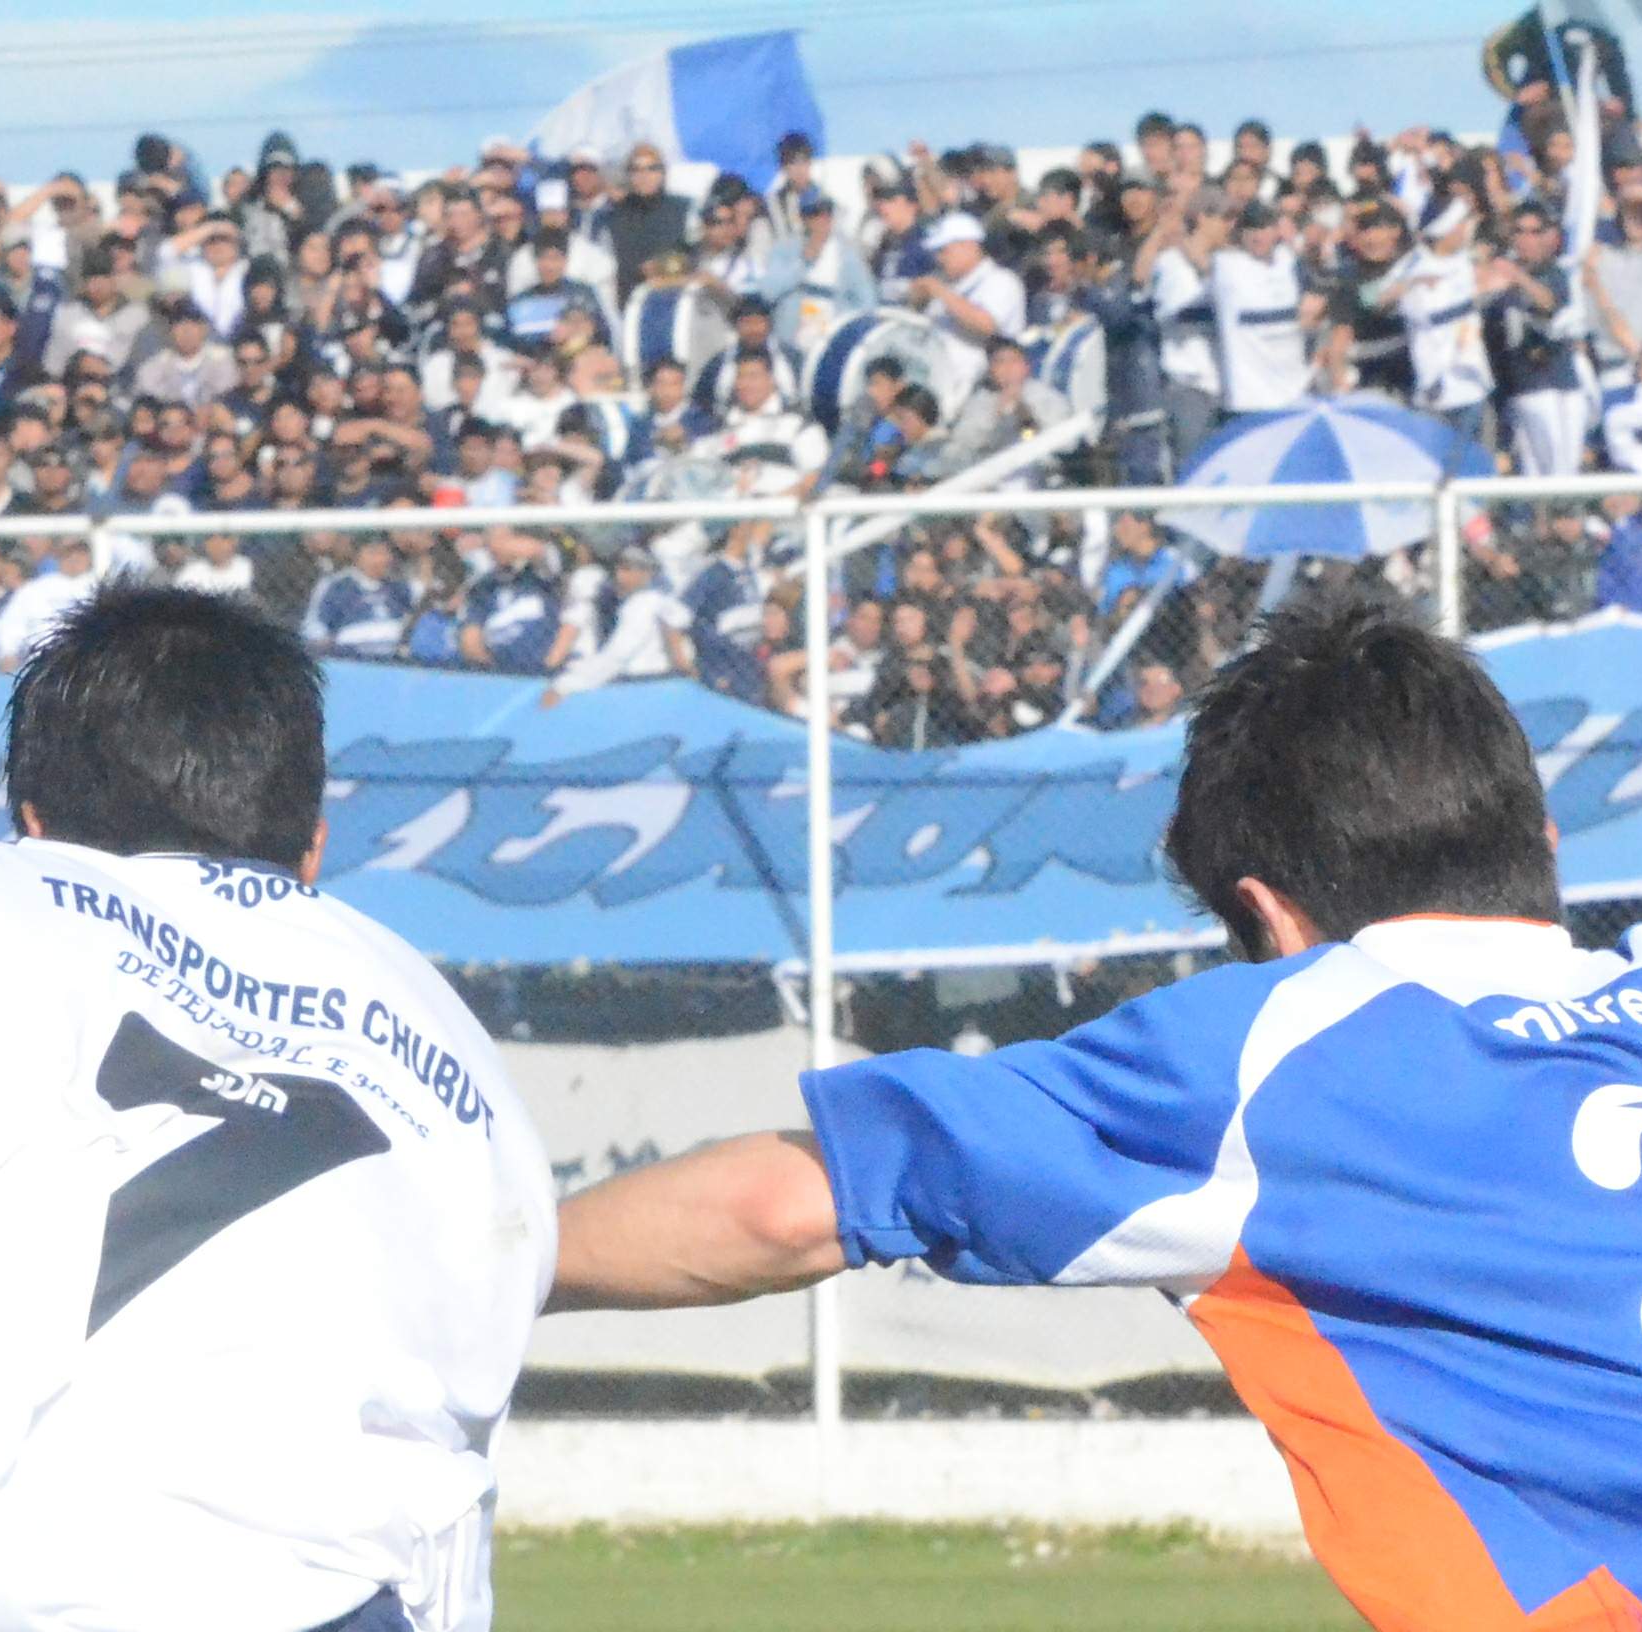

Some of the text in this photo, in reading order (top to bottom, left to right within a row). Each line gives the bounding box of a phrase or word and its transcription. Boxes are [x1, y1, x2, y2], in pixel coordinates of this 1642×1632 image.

[42, 876, 347, 1031] TRANSPORTES
[117, 950, 165, 987] DE
[362, 999, 495, 1141] CHUBUT
[85, 1010, 393, 1342] 7
